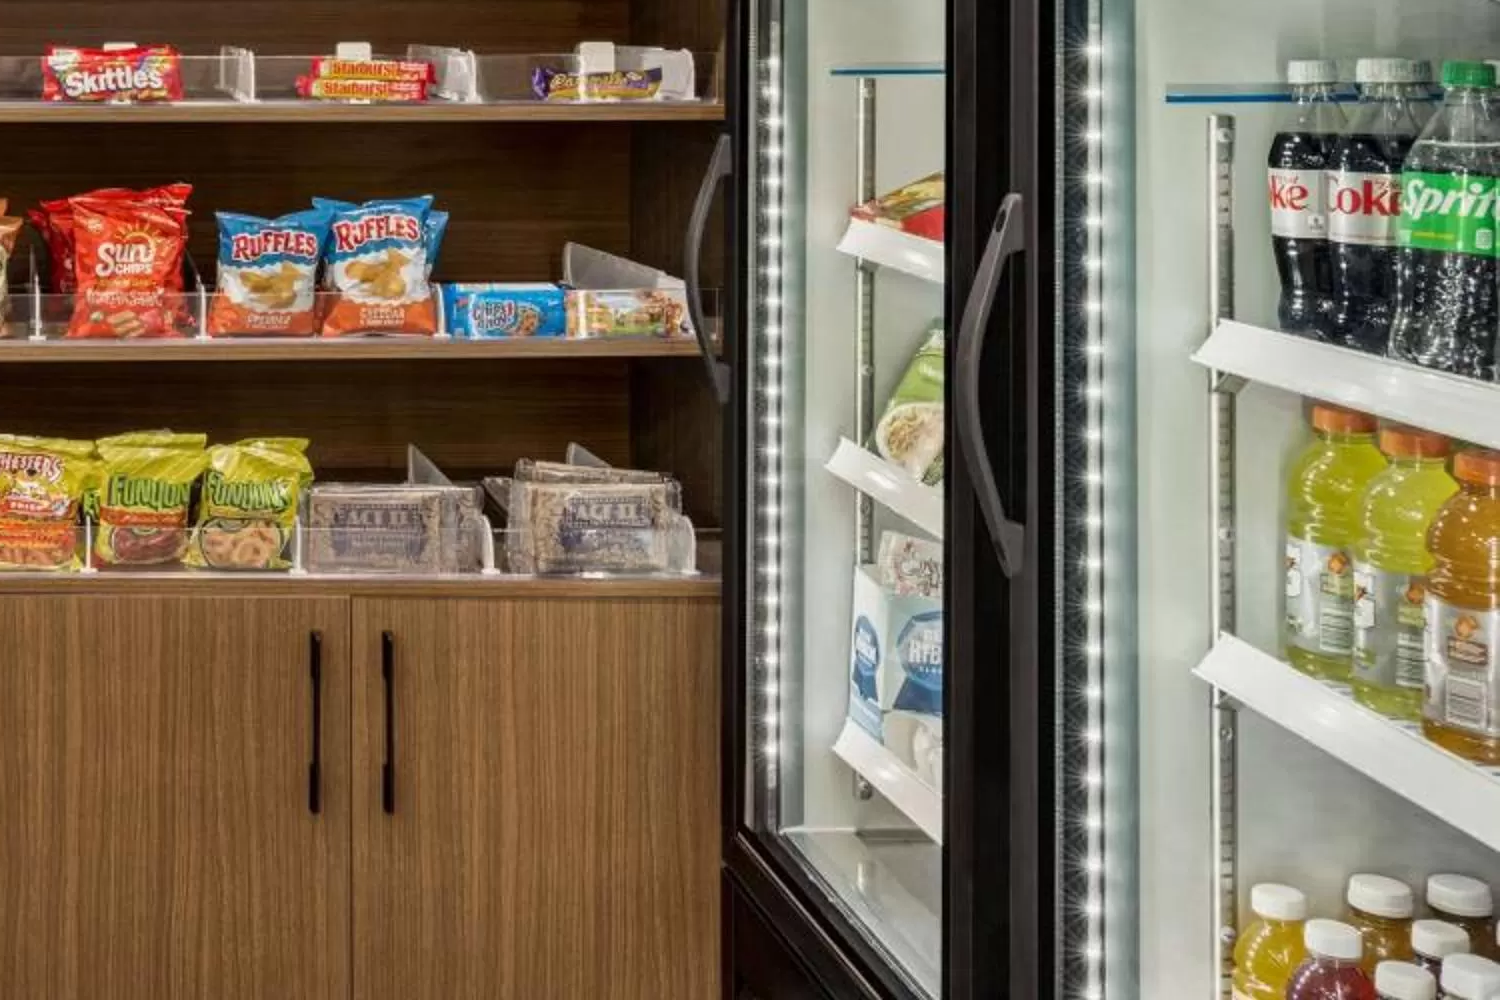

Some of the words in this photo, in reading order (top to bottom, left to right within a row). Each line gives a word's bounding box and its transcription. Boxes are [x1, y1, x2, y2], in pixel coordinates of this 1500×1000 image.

[65, 66, 164, 96] Skittles
[232, 230, 318, 262] RUFFLES
[334, 214, 421, 253] RUFFLES
[96, 242, 155, 277] Sun
[115, 263, 153, 274] CHIPS
